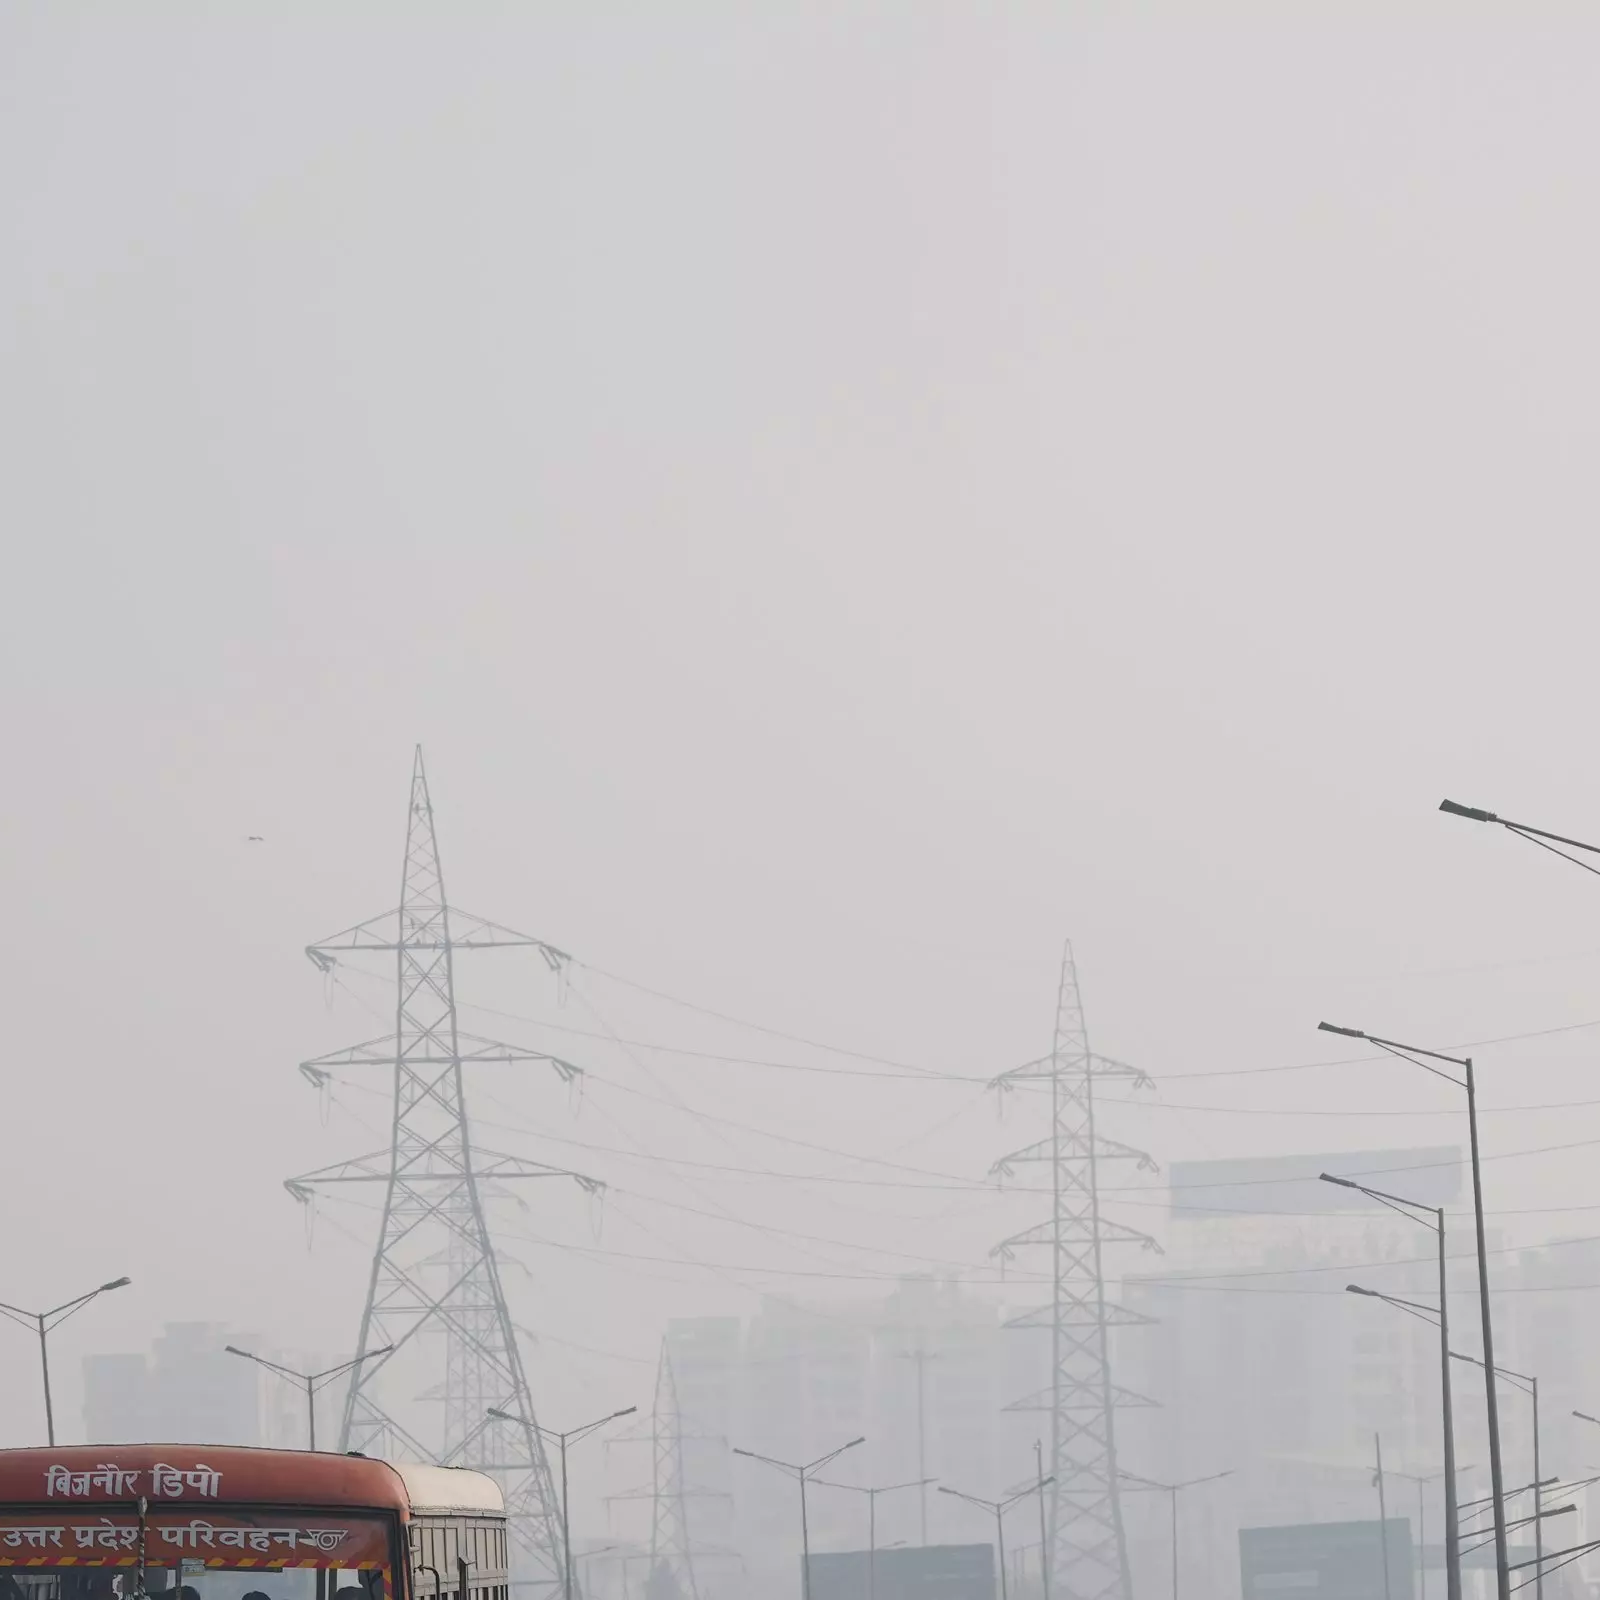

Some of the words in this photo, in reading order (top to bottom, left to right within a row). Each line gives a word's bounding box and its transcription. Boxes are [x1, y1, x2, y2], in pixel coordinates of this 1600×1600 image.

[148, 1463, 223, 1498] डिपो
[0, 1526, 66, 1548] उत्तर
[71, 1518, 151, 1551] प्रदेश
[157, 1520, 300, 1552] परिवहन
